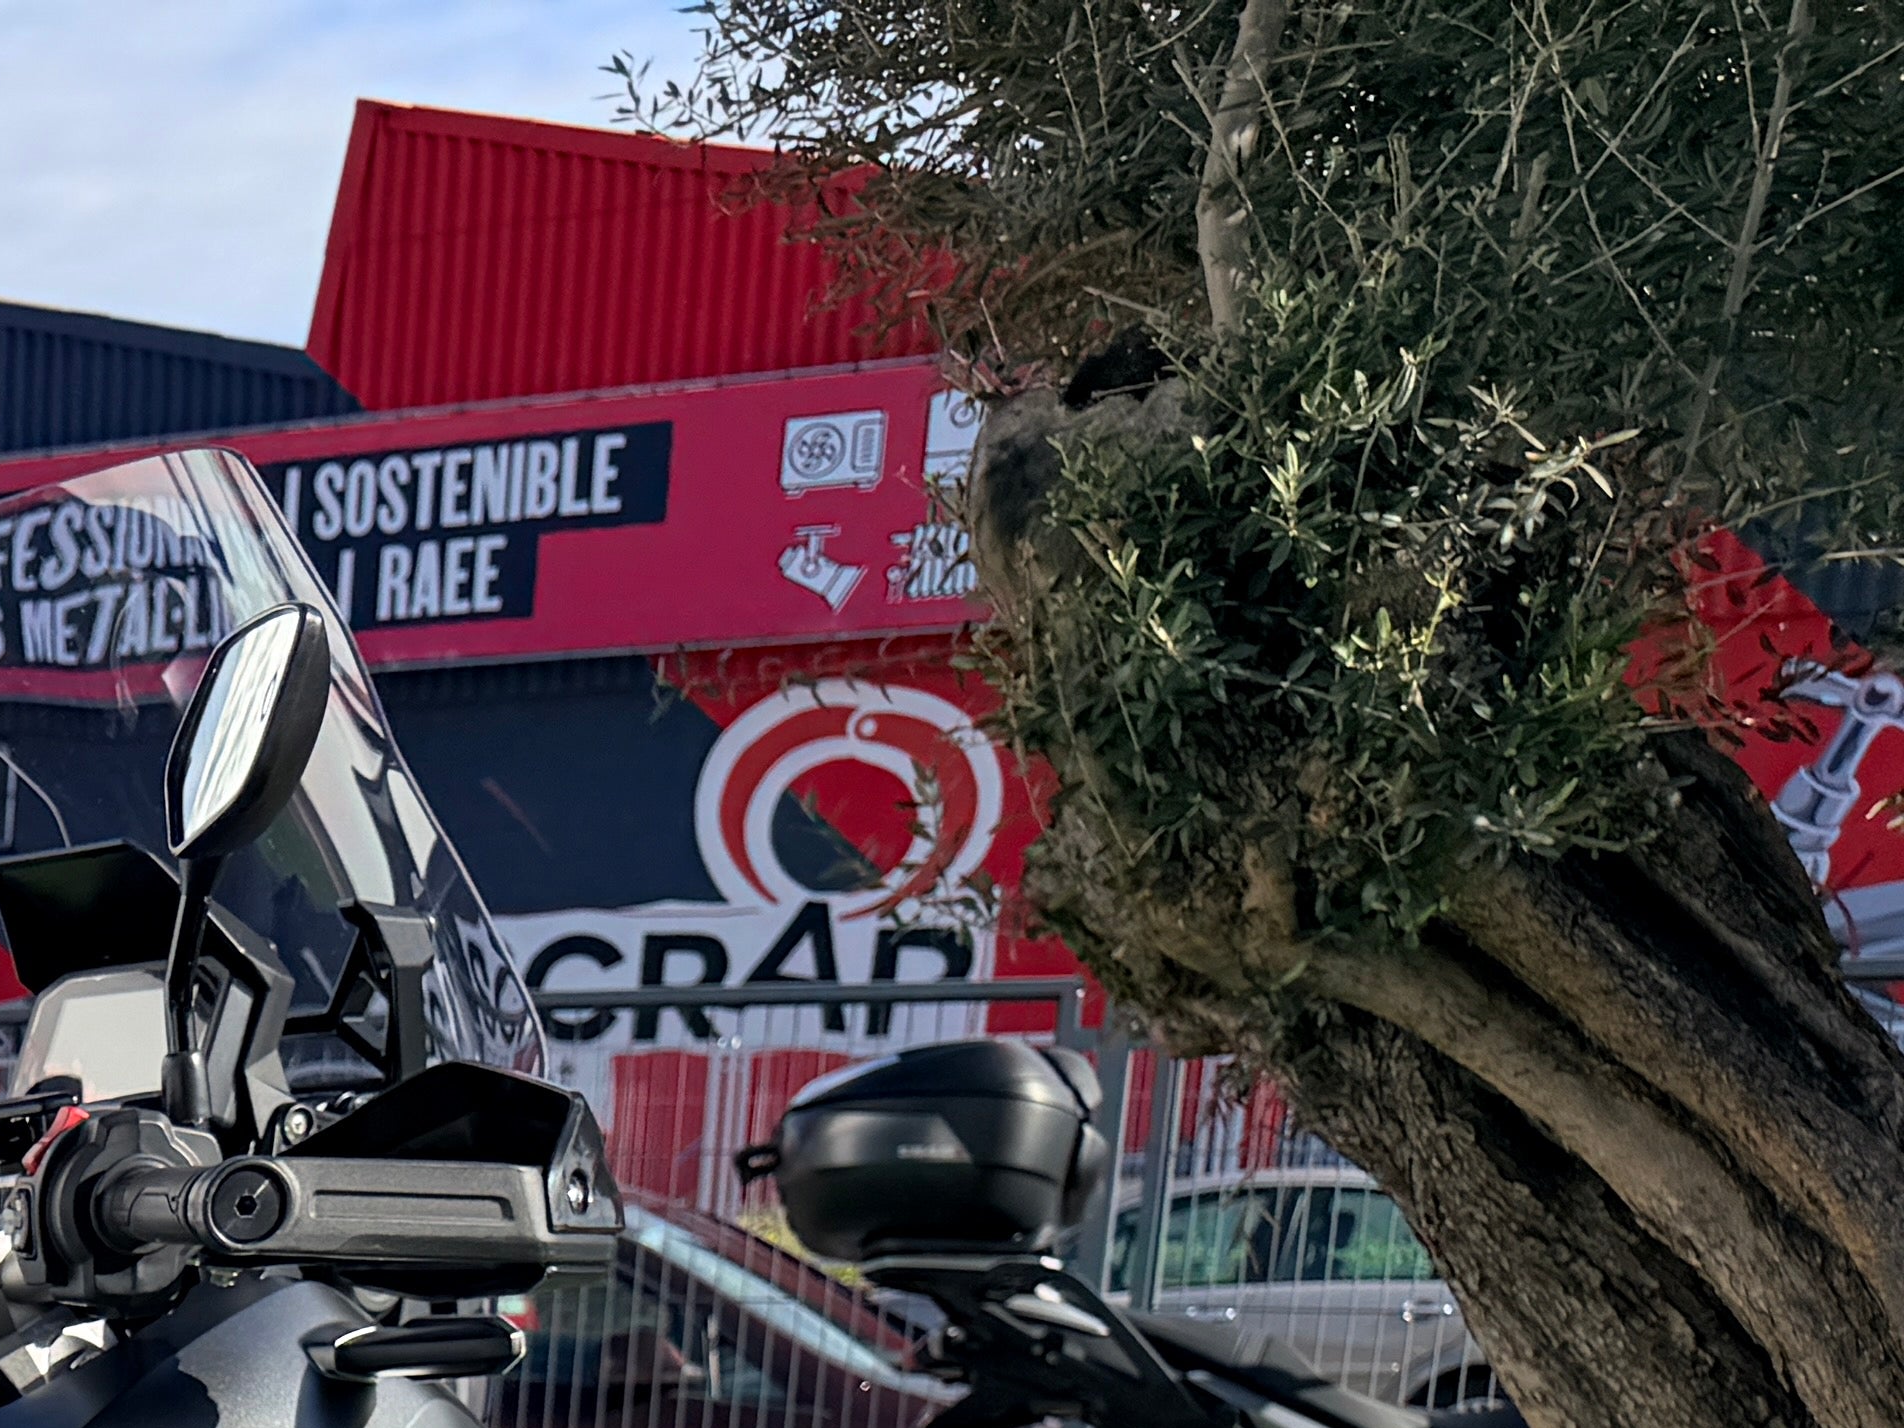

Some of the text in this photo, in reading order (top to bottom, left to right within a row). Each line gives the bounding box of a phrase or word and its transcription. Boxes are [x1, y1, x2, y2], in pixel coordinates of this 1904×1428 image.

[312, 433, 628, 541] SOSTENIBLE
[376, 534, 508, 621] RAEE
[460, 901, 975, 1041] CRAP
